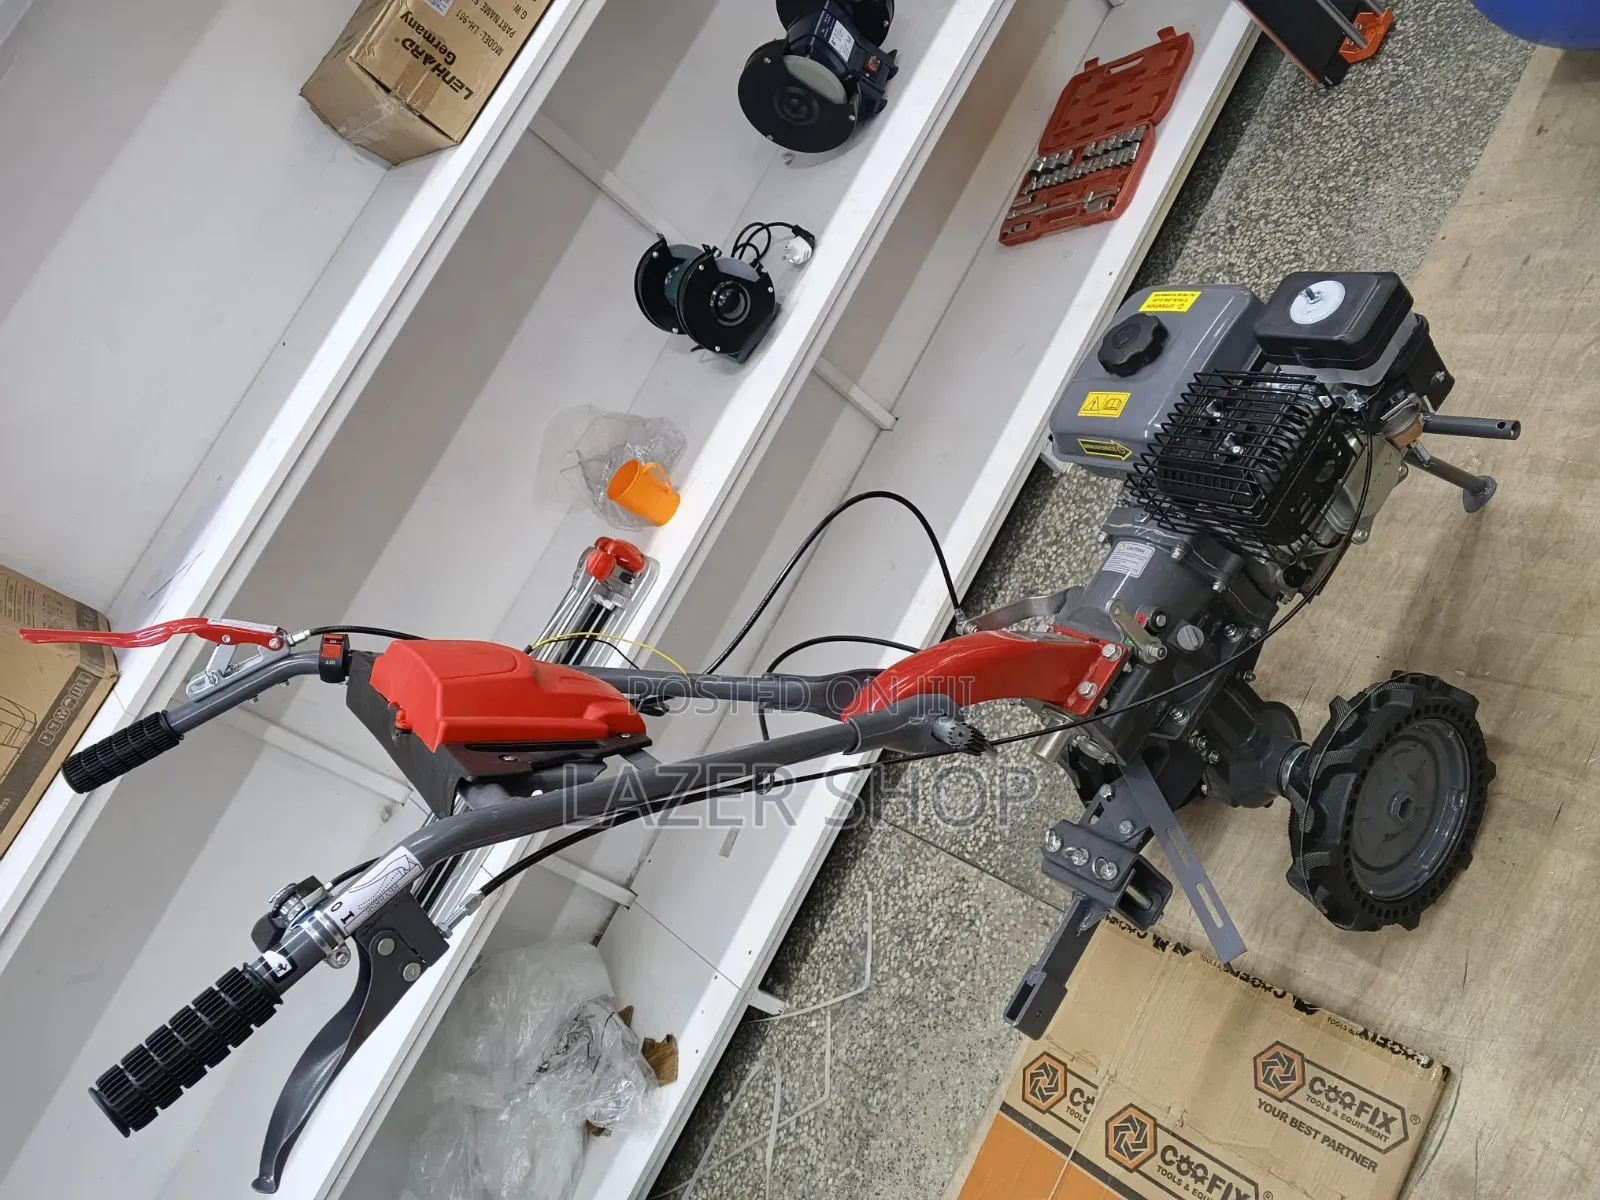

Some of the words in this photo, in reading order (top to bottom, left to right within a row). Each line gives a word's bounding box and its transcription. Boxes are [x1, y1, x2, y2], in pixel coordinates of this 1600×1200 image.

[456, 9, 480, 35] LH-901
[498, 20, 517, 39] PART
[400, 11, 457, 66] Germany
[480, 31, 504, 56] MODEL:
[401, 38, 474, 101] LENHARD
[365, 884, 400, 914] REVERSE
[1326, 1016, 1348, 1032] TOOLS
[1306, 1094, 1331, 1113] TOOLS
[1332, 1109, 1339, 1117] &
[1340, 1113, 1390, 1144] EQUIPMENT
[1309, 1076, 1398, 1135] COOFIX
[1257, 1098, 1289, 1124] YOUR
[1289, 1116, 1321, 1140] BEST
[1321, 1133, 1379, 1174] PARTNER
[1156, 1165, 1183, 1187] TOOLS
[1183, 1183, 1190, 1192] &
